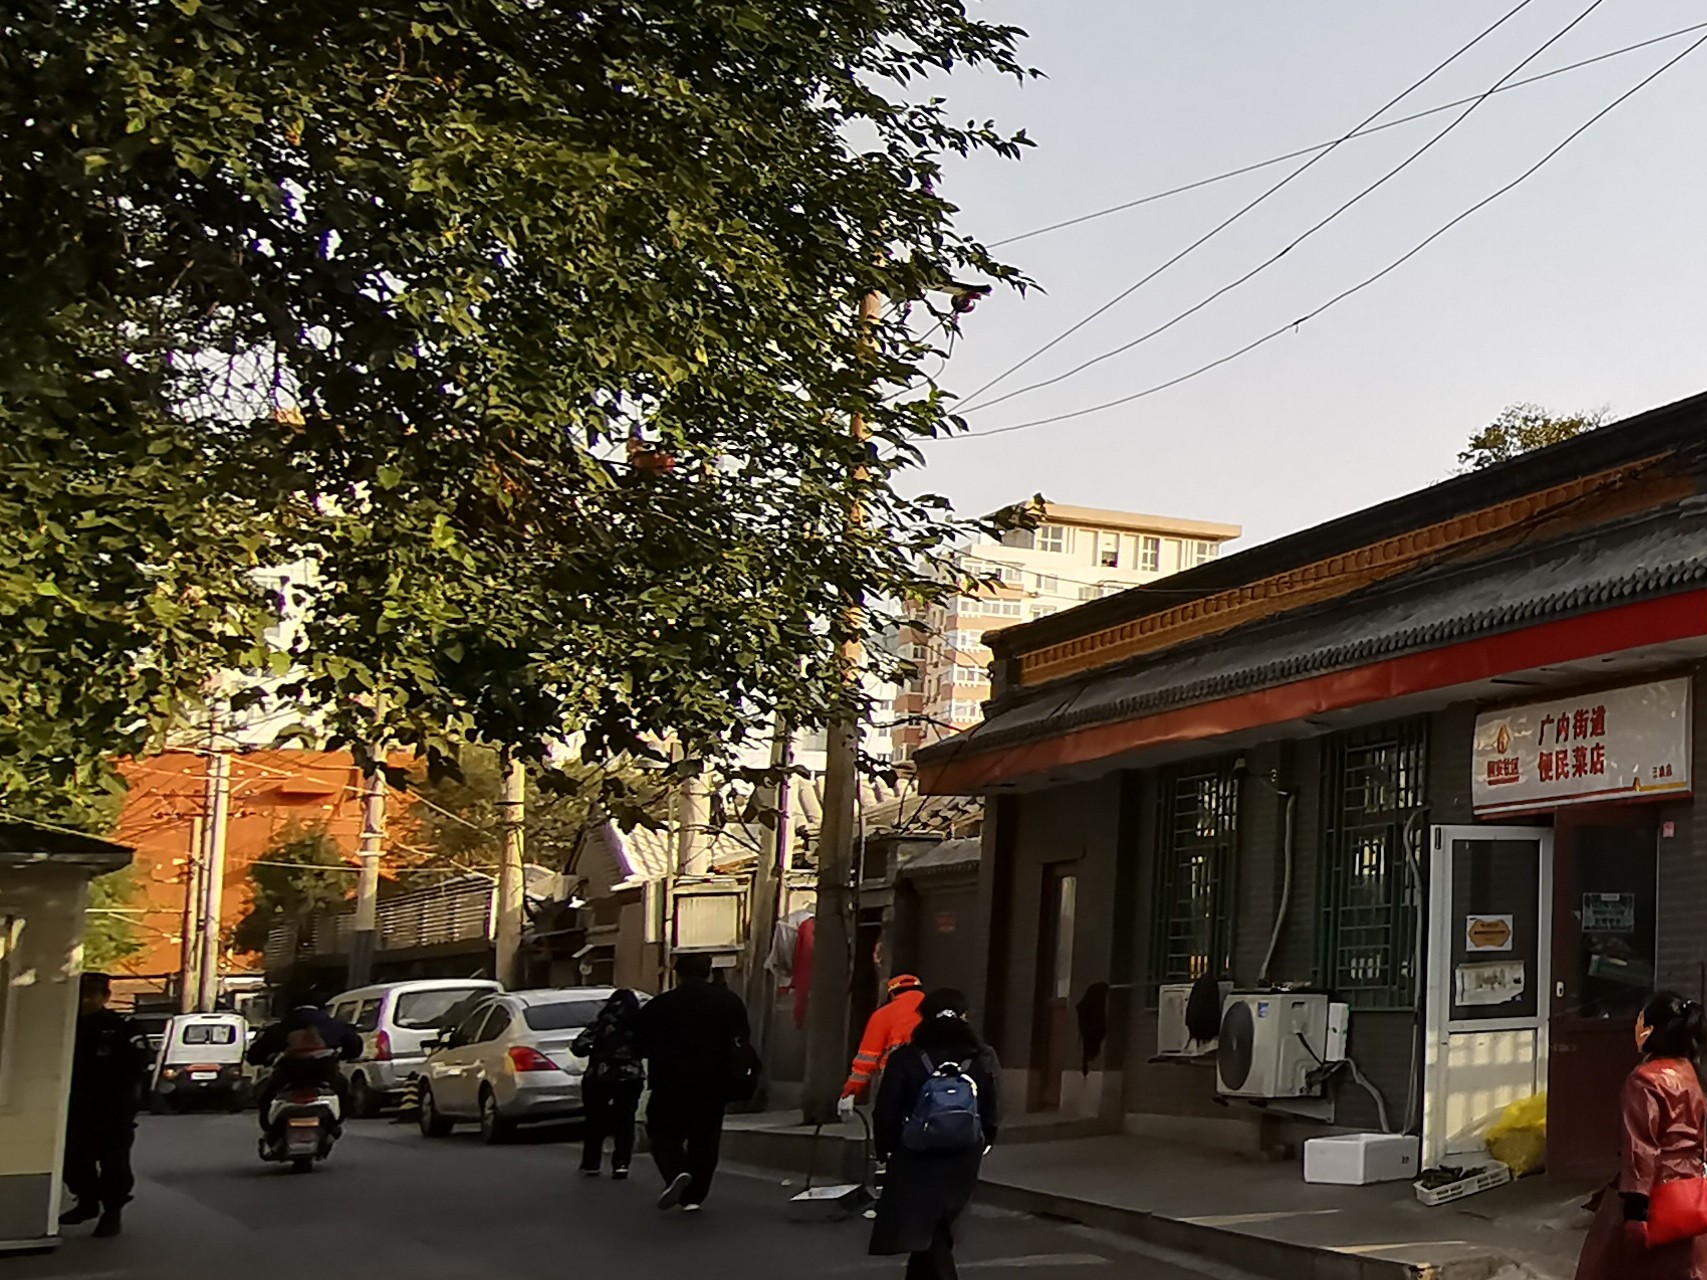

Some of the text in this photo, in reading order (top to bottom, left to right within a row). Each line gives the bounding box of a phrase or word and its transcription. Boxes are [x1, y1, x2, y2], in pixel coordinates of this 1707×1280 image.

[1537, 704, 1606, 746] 广内街道
[1537, 742, 1606, 782] 便民菜店
